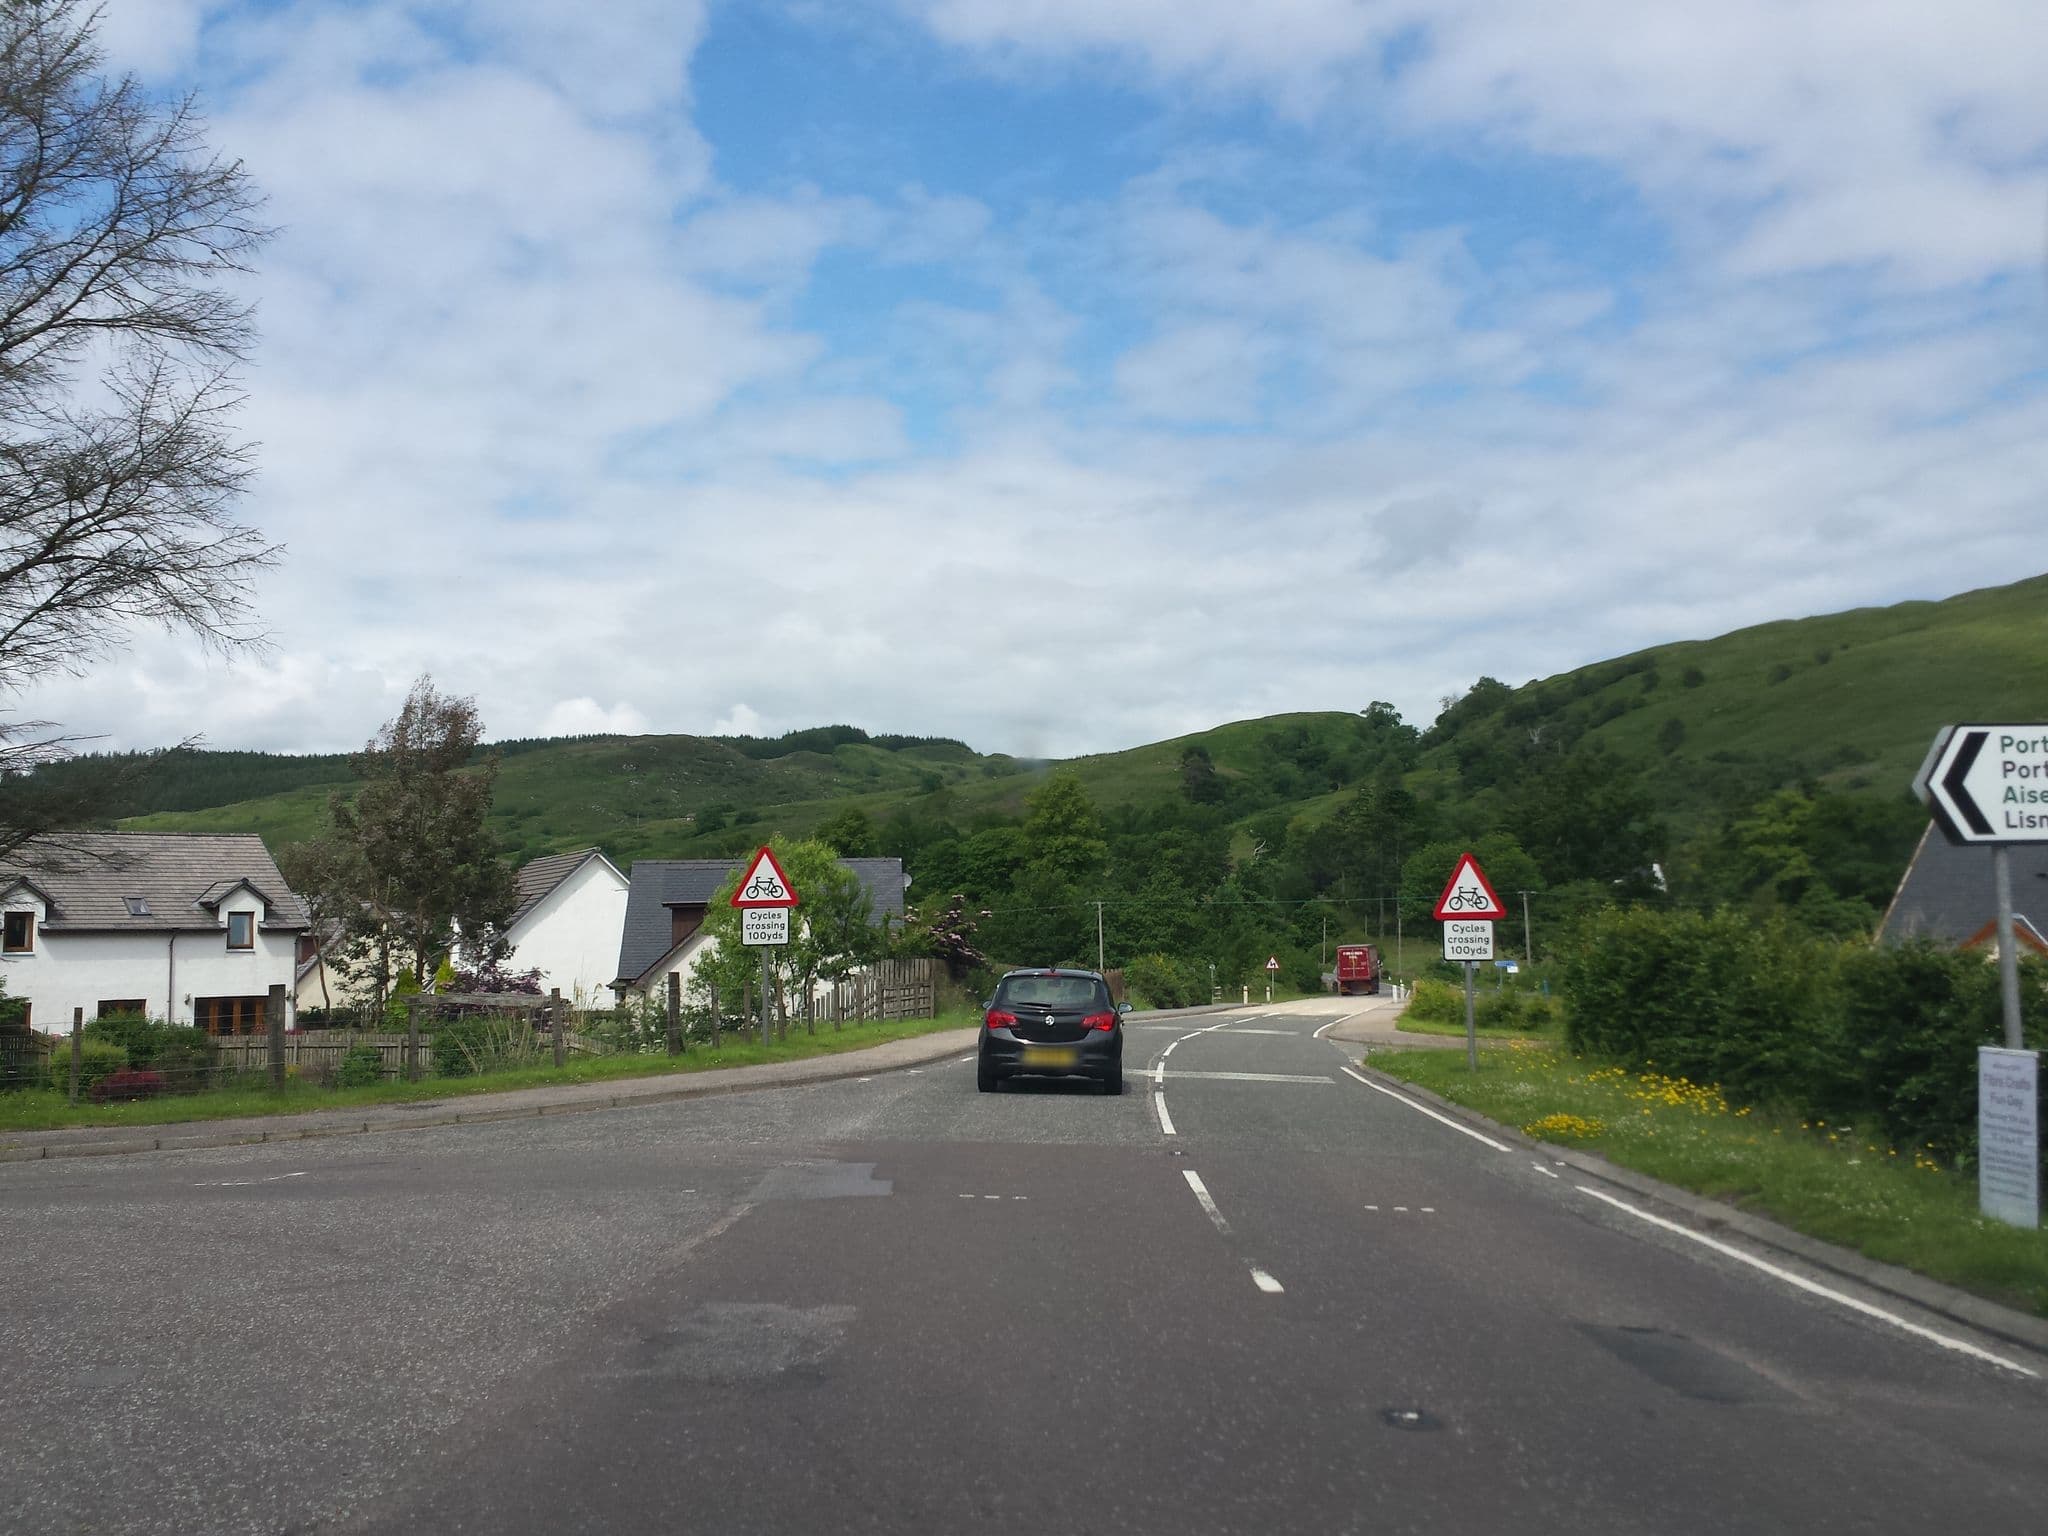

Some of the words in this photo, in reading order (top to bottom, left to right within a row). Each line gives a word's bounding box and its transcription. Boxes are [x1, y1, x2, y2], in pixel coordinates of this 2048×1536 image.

[2000, 735, 2048, 754] Port
[2003, 760, 2048, 779] Port
[2003, 785, 2048, 804] Aise
[750, 912, 782, 921] Cycles
[745, 921, 786, 931] crossing
[1451, 924, 1486, 935] Cycles
[748, 931, 784, 941] 100yds
[1447, 935, 1490, 945] crossing
[1451, 945, 1488, 956] 100yds
